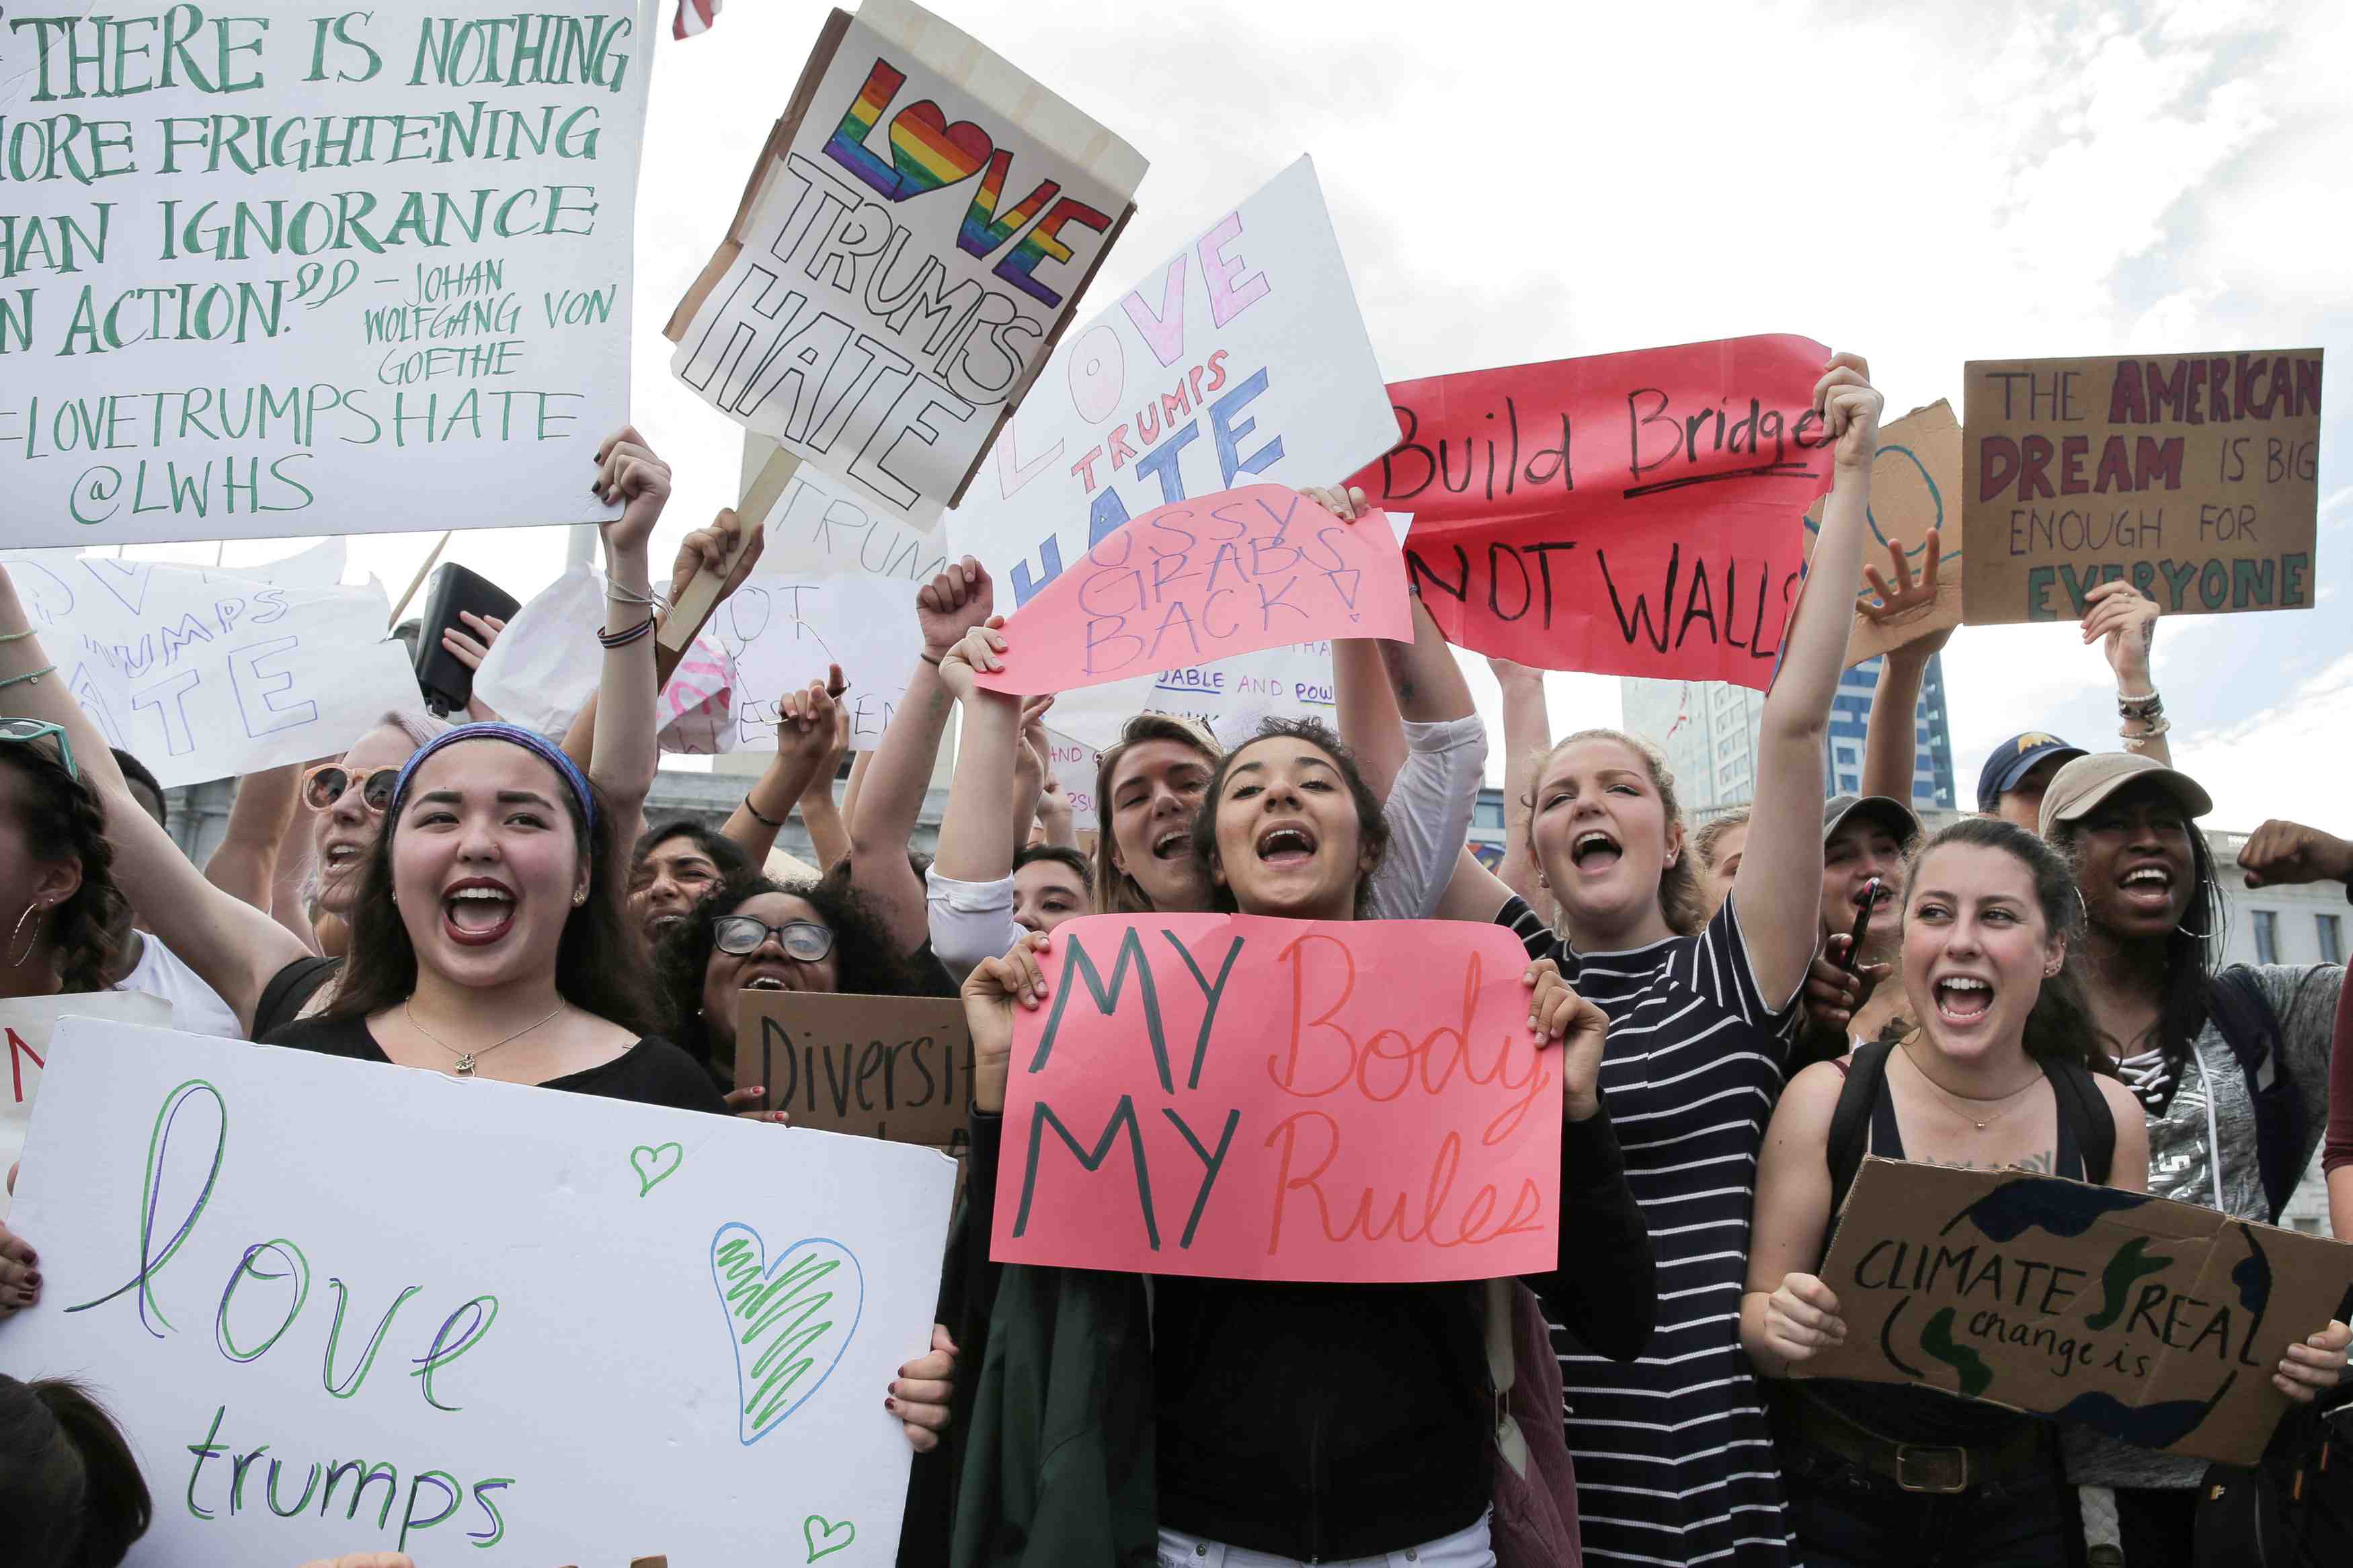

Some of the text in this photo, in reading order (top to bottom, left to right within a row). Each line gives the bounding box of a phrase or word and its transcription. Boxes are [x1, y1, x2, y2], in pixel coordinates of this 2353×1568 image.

[9, 4, 633, 102] THERE IS NOTHING
[0, 101, 600, 185] ORE FRIGHTENING
[157, 185, 600, 260] IGNORANCE
[364, 284, 616, 345] WOLFGANG VON
[788, 153, 1043, 406] TRUMPS
[378, 340, 526, 386] GOETHE
[680, 263, 976, 511] HATE
[997, 211, 1271, 500] LOVE
[1985, 354, 2321, 425] THE AMERICAN
[1071, 349, 1229, 494] TRUMPS
[1382, 395, 1574, 500] Build
[70, 453, 315, 526] @LWHS
[1980, 435, 2317, 503] DREAM IS BIG
[1078, 528, 1346, 618] GRABS
[2010, 504, 2258, 556] ENOUGH FOR
[714, 585, 820, 641] OT
[1406, 542, 1576, 630] NOT
[1237, 675, 1283, 696] AND
[1295, 683, 1332, 700] POW
[1028, 926, 1552, 1146] MY Body
[1012, 1094, 1545, 1255] MY Rules
[63, 1078, 499, 1411] love
[1854, 1239, 2261, 1367] CLIMATE REAL
[1968, 1309, 2150, 1378] change is
[186, 1404, 516, 1553] trumps
